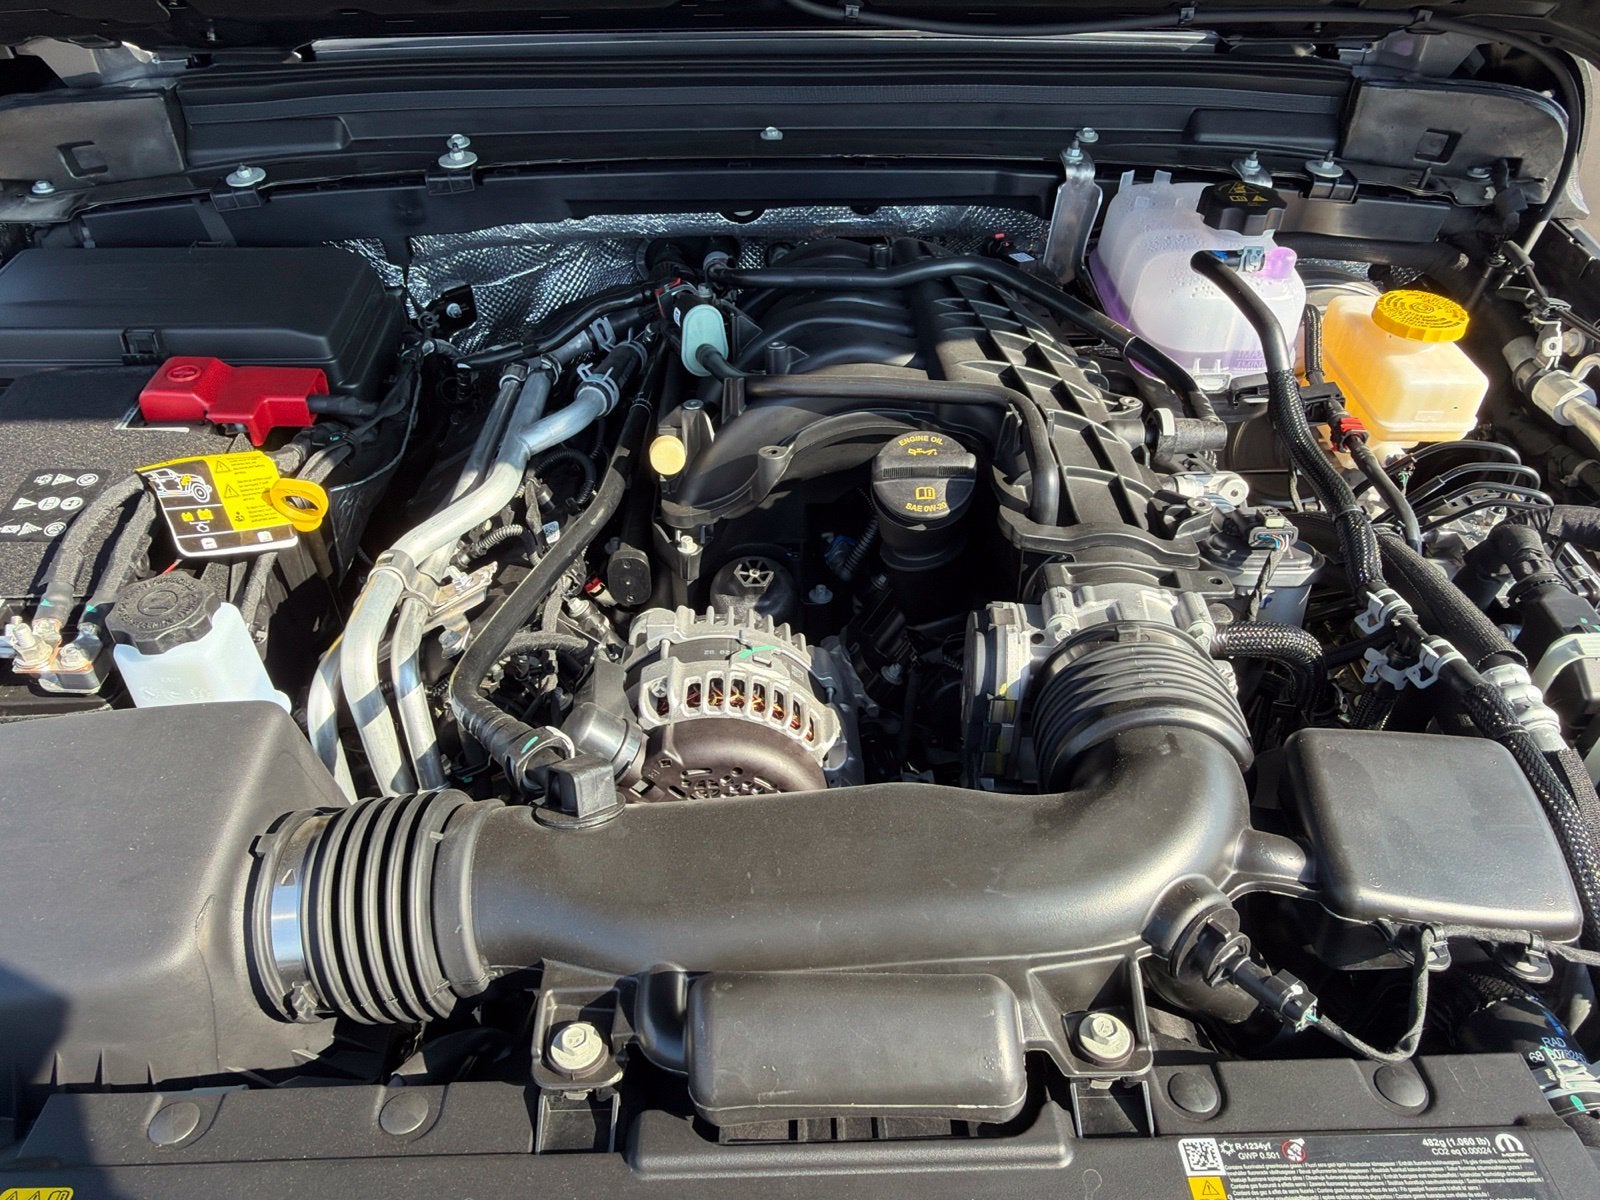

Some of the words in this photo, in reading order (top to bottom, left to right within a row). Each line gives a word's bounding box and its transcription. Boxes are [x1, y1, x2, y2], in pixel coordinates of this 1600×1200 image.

[899, 435, 929, 446] ENGINE
[930, 435, 943, 445] OIL
[905, 502, 922, 512] SAE
[924, 502, 947, 512] 0W-20
[1541, 1036, 1566, 1048] RAD
[1235, 1142, 1271, 1151] R-1234yf
[1238, 1152, 1258, 1160] GWP
[1259, 1151, 1280, 1159] 0.501
